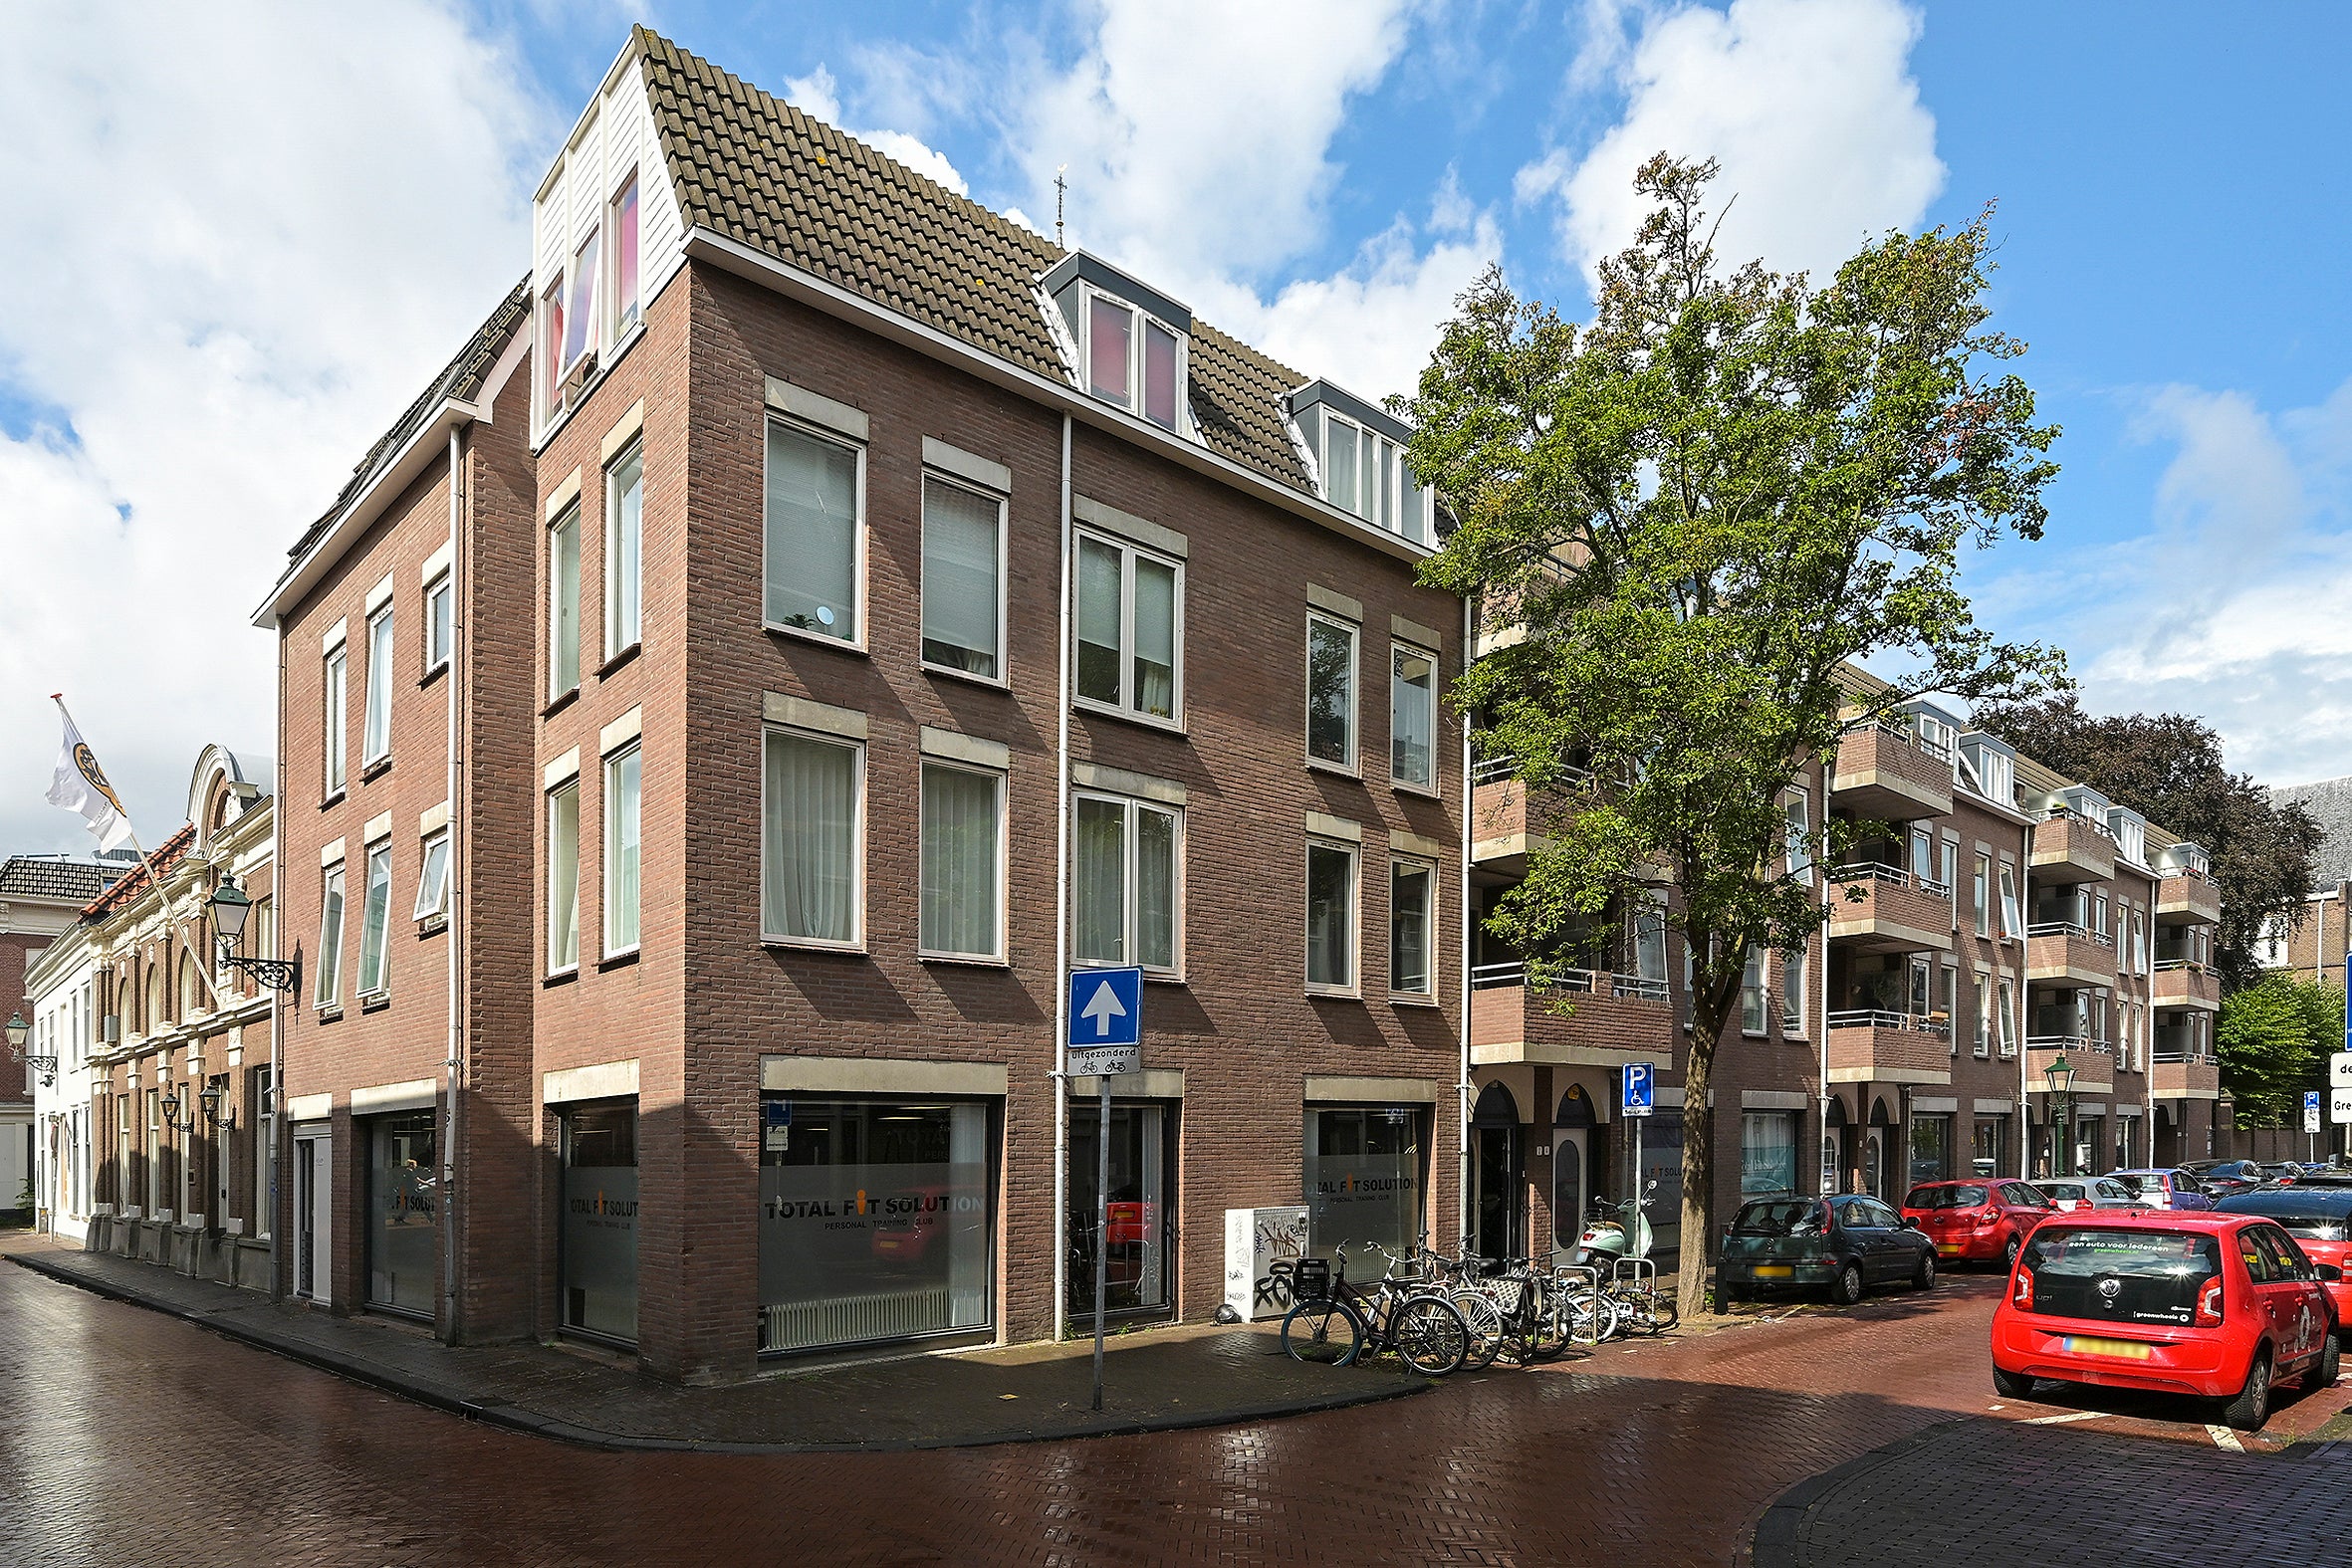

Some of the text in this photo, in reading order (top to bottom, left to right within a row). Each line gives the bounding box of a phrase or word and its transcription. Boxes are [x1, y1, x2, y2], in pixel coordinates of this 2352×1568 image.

[1071, 1048, 1136, 1060] uitgezonderd
[1629, 1066, 1647, 1090] P
[765, 1200, 836, 1220] TOTAL
[885, 1196, 984, 1214] SOLUTION
[824, 1222, 866, 1231] PERSONAL
